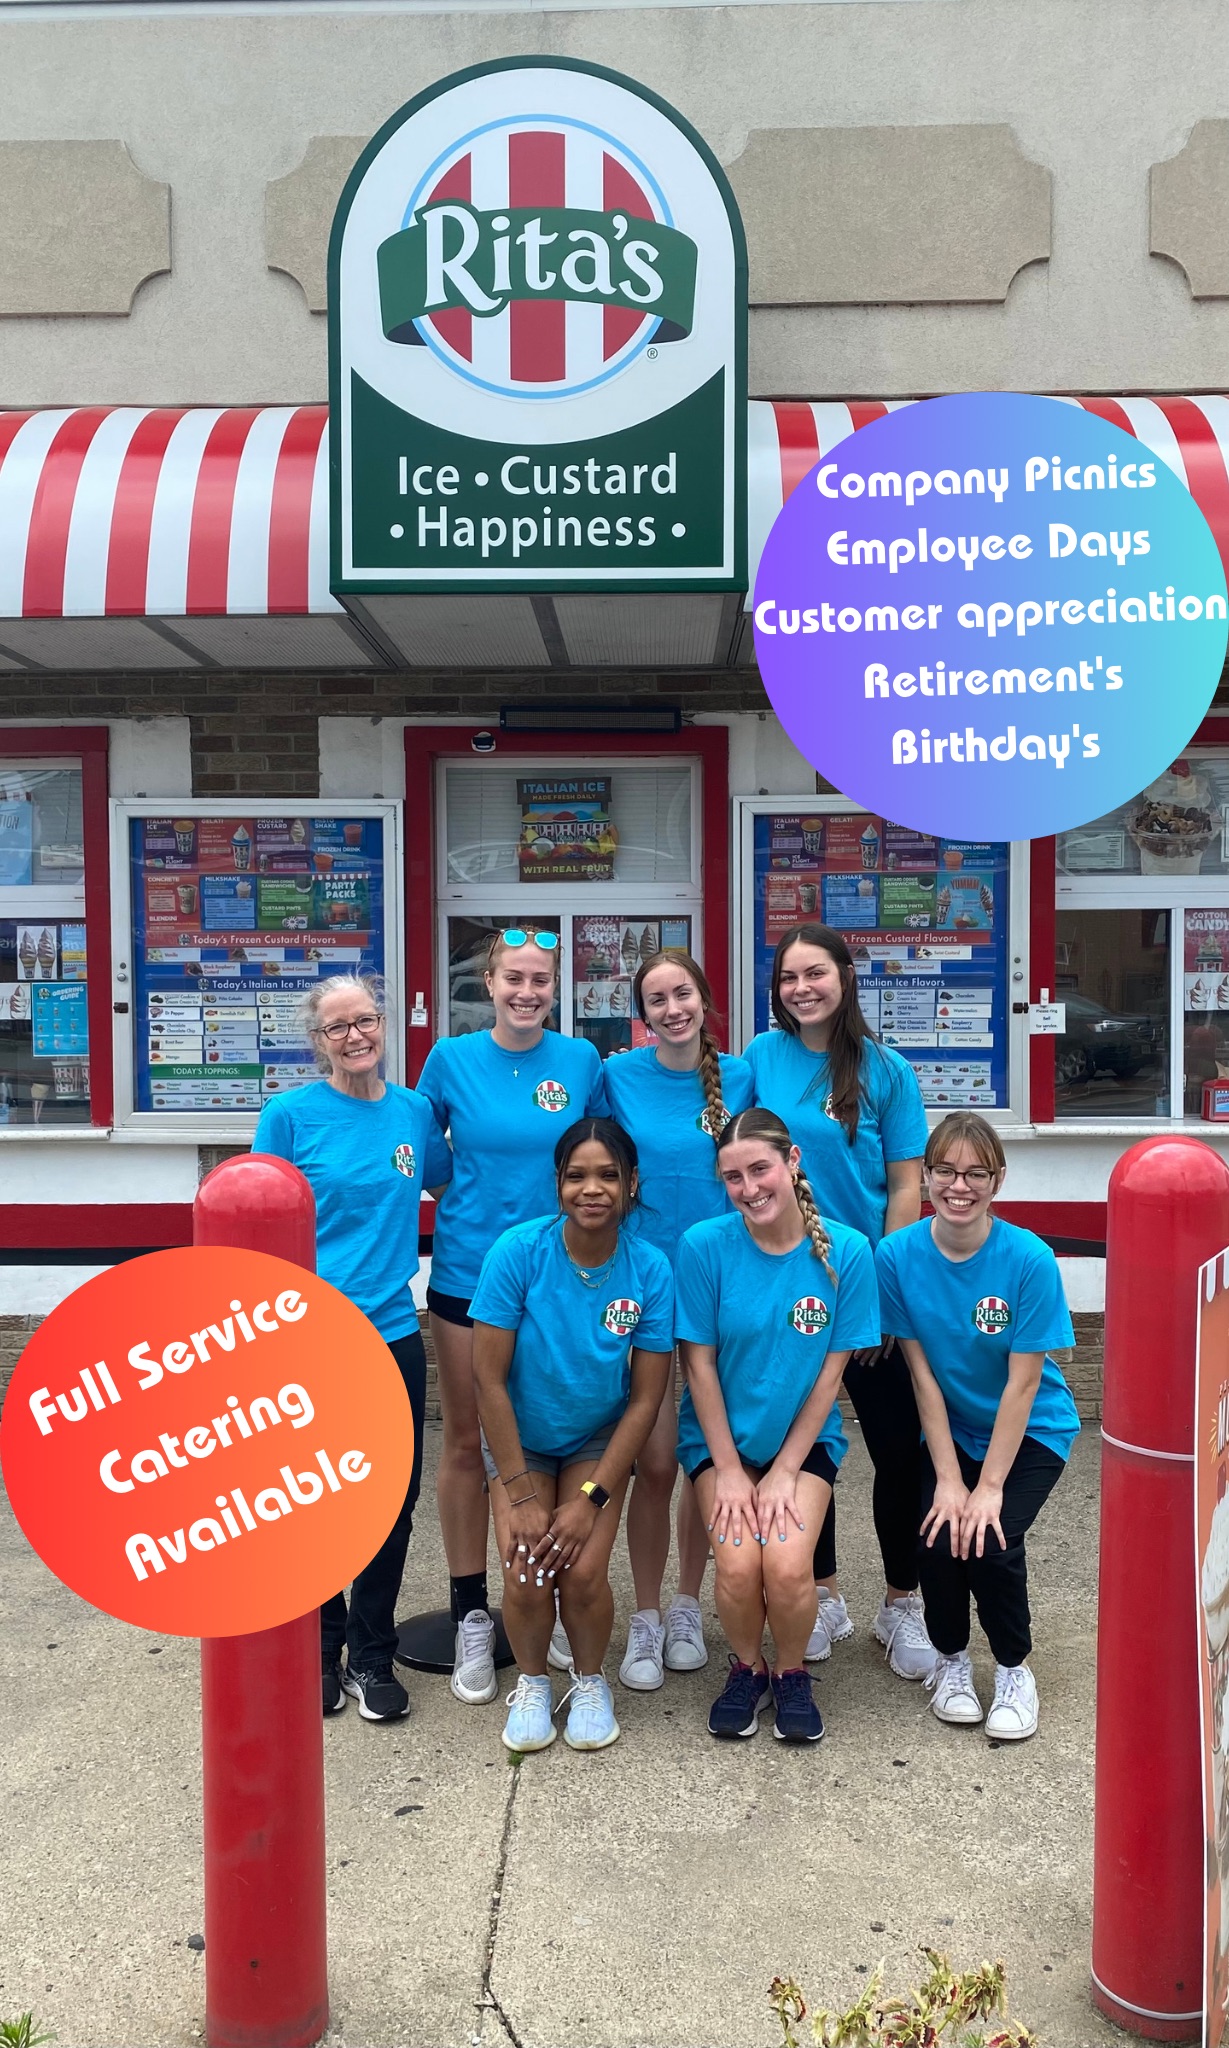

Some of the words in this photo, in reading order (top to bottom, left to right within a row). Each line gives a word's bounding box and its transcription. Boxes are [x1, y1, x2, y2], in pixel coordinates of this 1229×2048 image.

[422, 205, 664, 311] Rita's
[398, 456, 460, 495] Ice
[500, 452, 677, 495] Custard
[418, 505, 656, 558] Happiness
[523, 784, 577, 794] ITALIAN
[583, 782, 606, 792] ICE
[325, 882, 356, 890] PARTY
[326, 890, 356, 899] PACKS
[1186, 919, 1229, 931] CANDY
[193, 935, 227, 946] Today's
[230, 935, 261, 944] Frozen
[264, 935, 300, 944] Custard
[303, 935, 336, 944] Flavors
[851, 934, 882, 943] Frozen
[885, 934, 923, 943] Custard
[924, 933, 958, 942] Flavors
[212, 980, 247, 990] Today's
[249, 980, 278, 989] Italian
[281, 980, 294, 988] Ice
[297, 979, 318, 988] Flav
[863, 978, 893, 987] Italian
[896, 978, 909, 986] Ice
[912, 977, 945, 986] Flavors
[52, 986, 84, 997] ORDERING
[60, 993, 79, 1001] GUIDE
[537, 1089, 568, 1102] Rita's
[702, 1114, 730, 1126] Ra's
[606, 1308, 640, 1324] Rita's
[793, 1307, 827, 1323] Rita's
[976, 1306, 1008, 1323] Rita's
